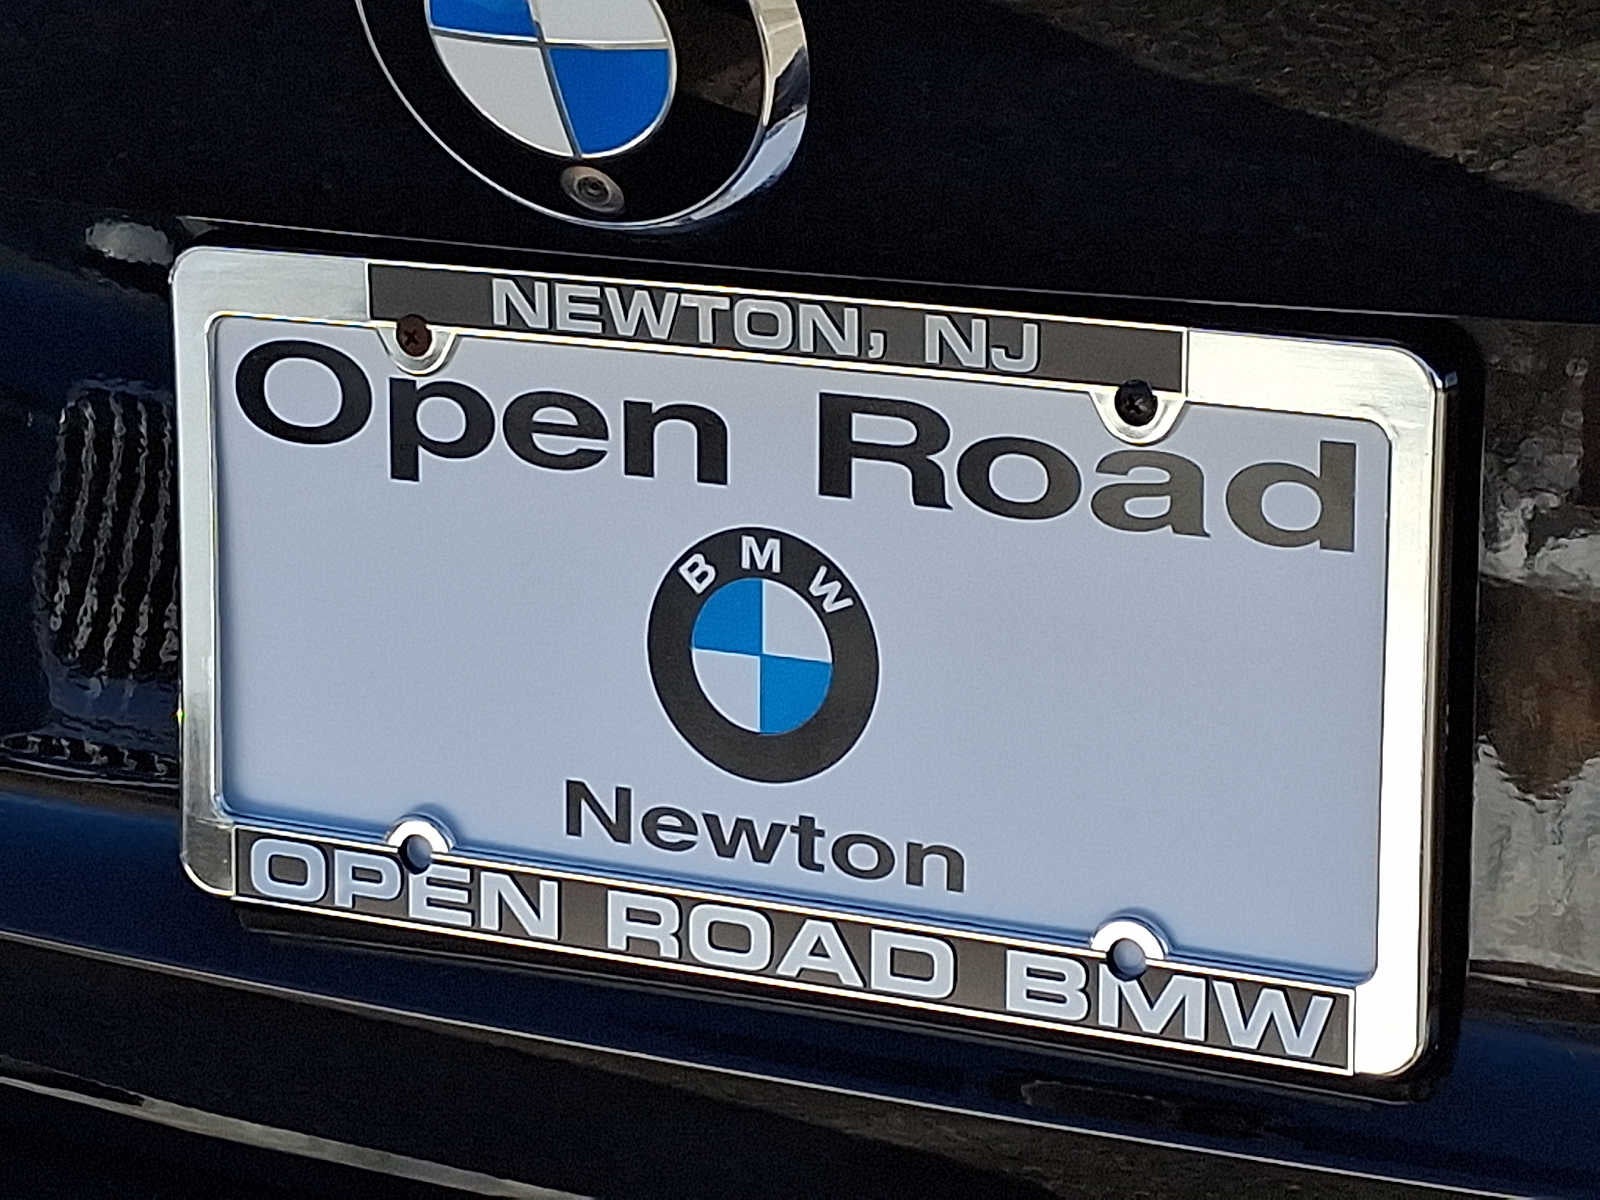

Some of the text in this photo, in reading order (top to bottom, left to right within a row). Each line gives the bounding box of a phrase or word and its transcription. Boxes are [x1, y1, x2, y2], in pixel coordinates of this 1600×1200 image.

[492, 277, 1041, 374] NEWTON, NJ
[235, 339, 1356, 553] Open Road
[678, 534, 854, 614] BMW
[565, 778, 967, 894] Newton
[250, 837, 1335, 1060] OPEN ROAD BMW
